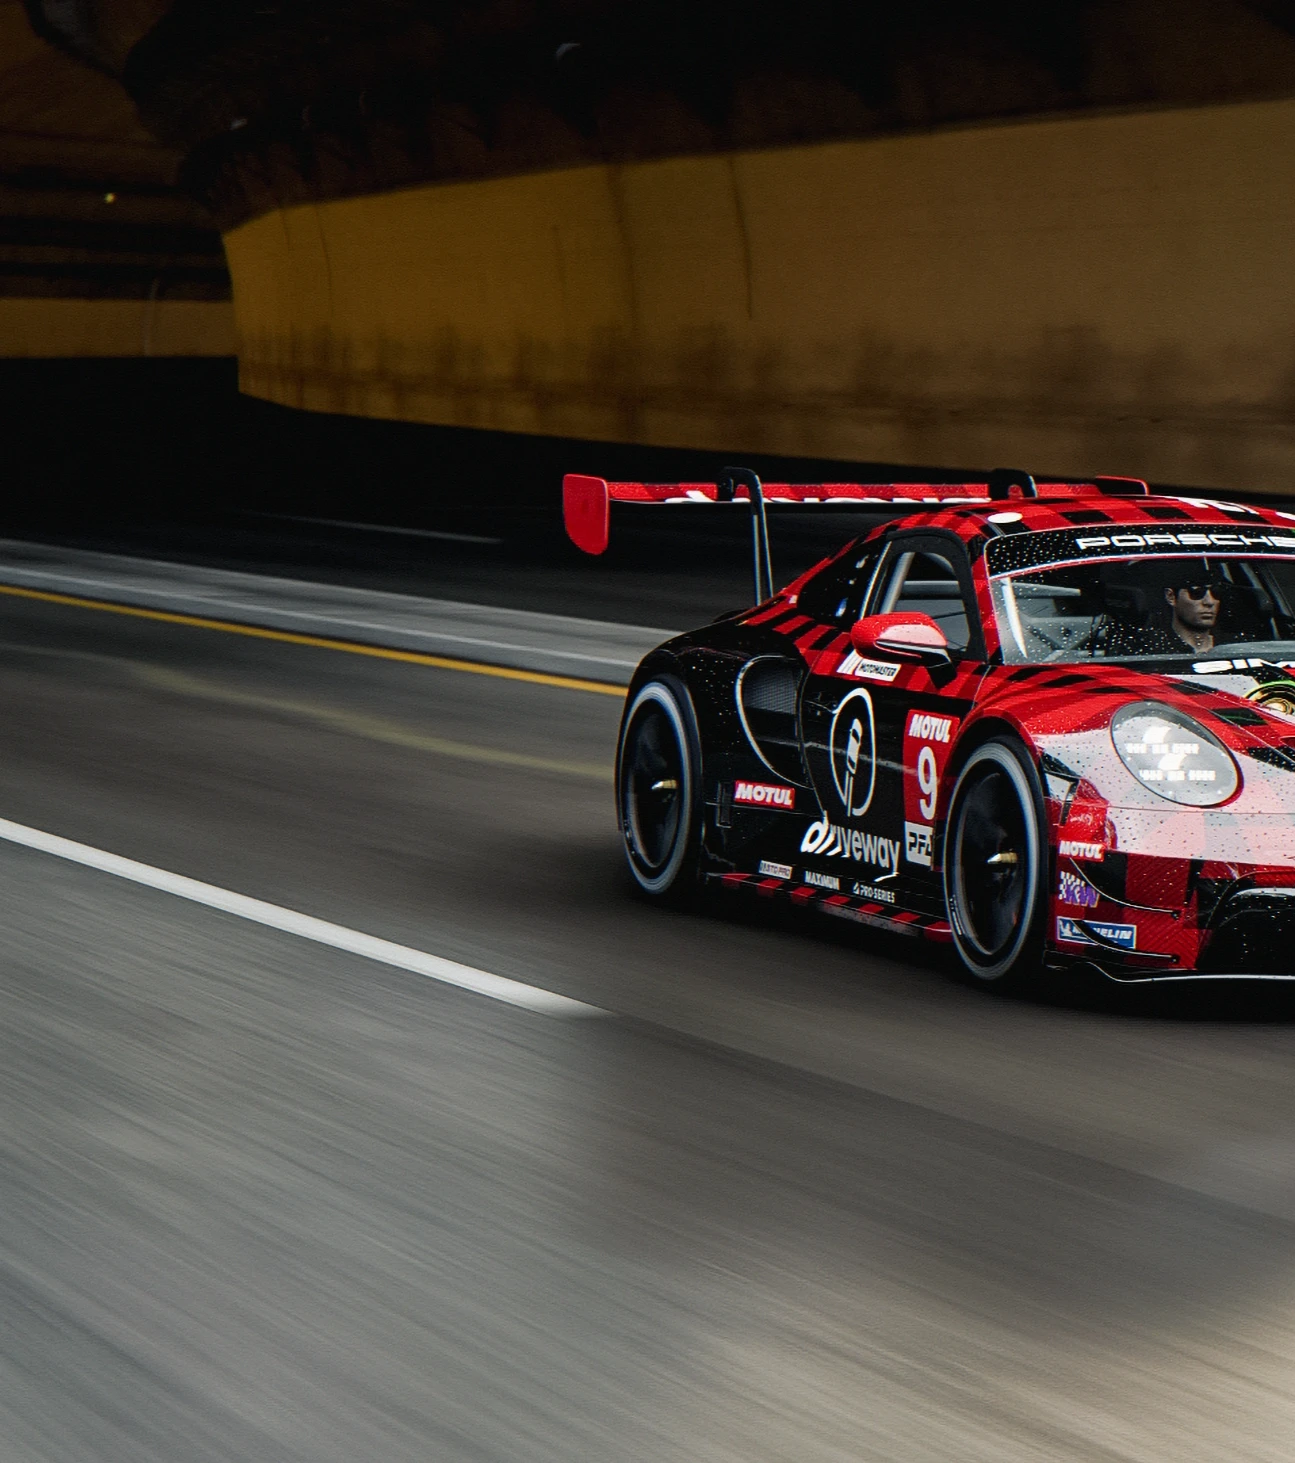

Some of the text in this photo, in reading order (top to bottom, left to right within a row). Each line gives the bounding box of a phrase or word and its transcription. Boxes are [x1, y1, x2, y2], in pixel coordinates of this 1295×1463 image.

[909, 713, 952, 743] MOTUL
[735, 783, 793, 807] MOTUL
[917, 746, 937, 820] 9
[800, 810, 900, 882] driveway
[1059, 840, 1103, 859] MOTUL
